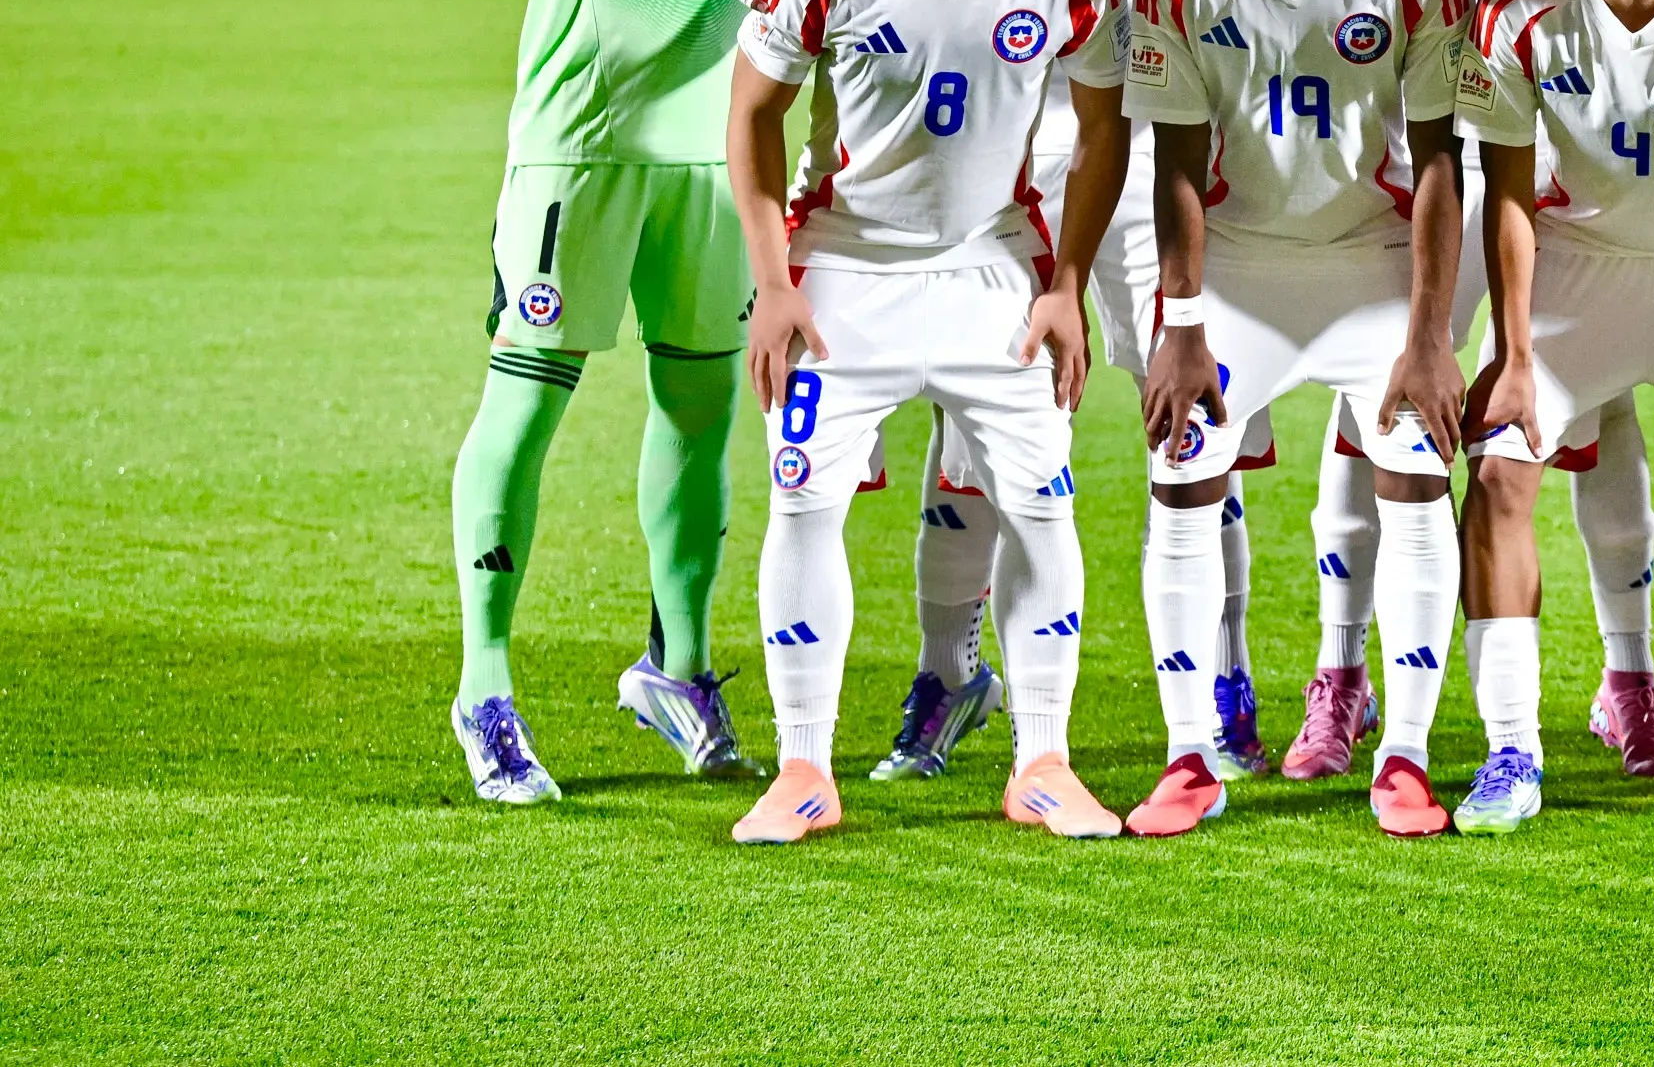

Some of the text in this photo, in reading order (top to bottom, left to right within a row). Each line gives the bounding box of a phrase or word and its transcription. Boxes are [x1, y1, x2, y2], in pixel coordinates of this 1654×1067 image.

[1132, 49, 1164, 65] U17
[1462, 69, 1492, 91] U17
[924, 71, 968, 136] 8
[1268, 75, 1331, 138] 19
[1460, 84, 1480, 92] WORLD
[1611, 122, 1650, 176] 4
[538, 201, 561, 274] 1
[782, 370, 822, 444] 8
